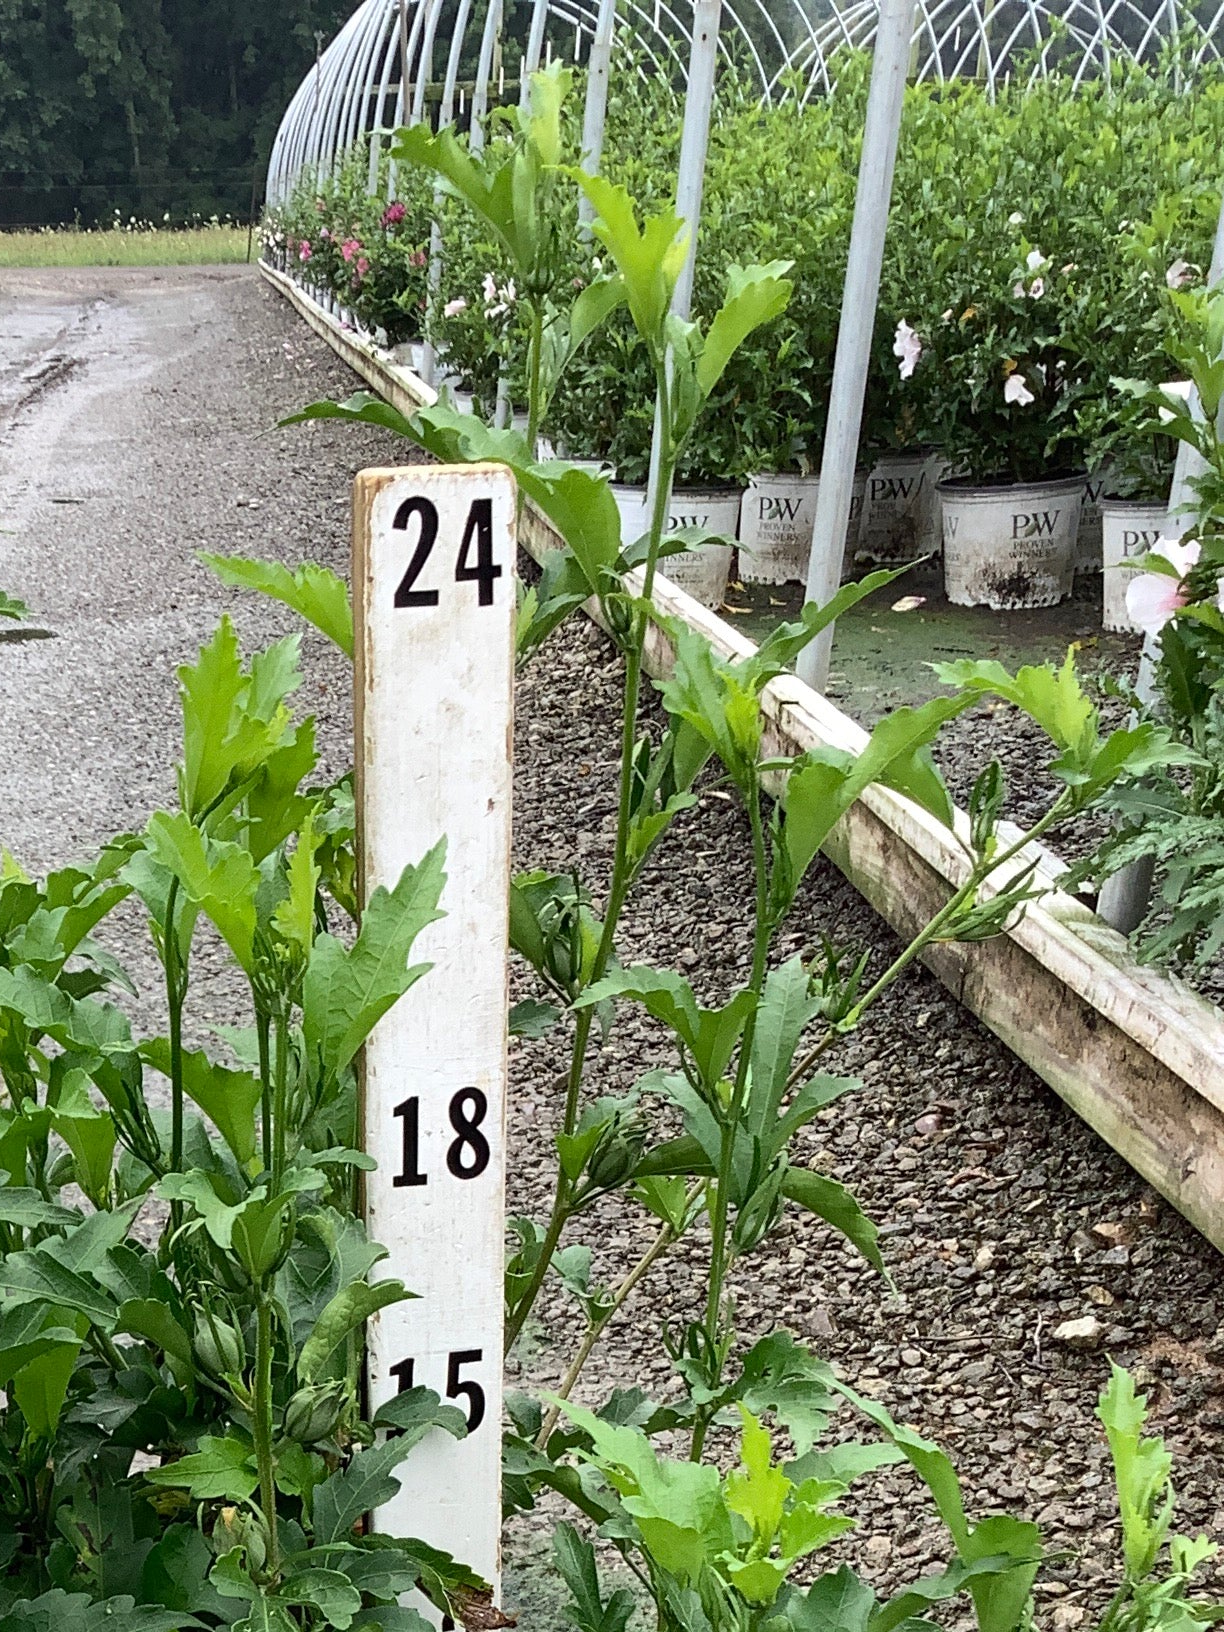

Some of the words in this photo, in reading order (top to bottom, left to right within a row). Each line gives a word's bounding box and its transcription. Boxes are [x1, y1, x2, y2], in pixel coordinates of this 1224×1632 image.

[870, 477, 914, 500] PW
[759, 496, 804, 521] PW
[1010, 510, 1062, 539] PW
[392, 495, 503, 609] 24
[664, 552, 704, 562] INNERS
[392, 1086, 490, 1188] 18
